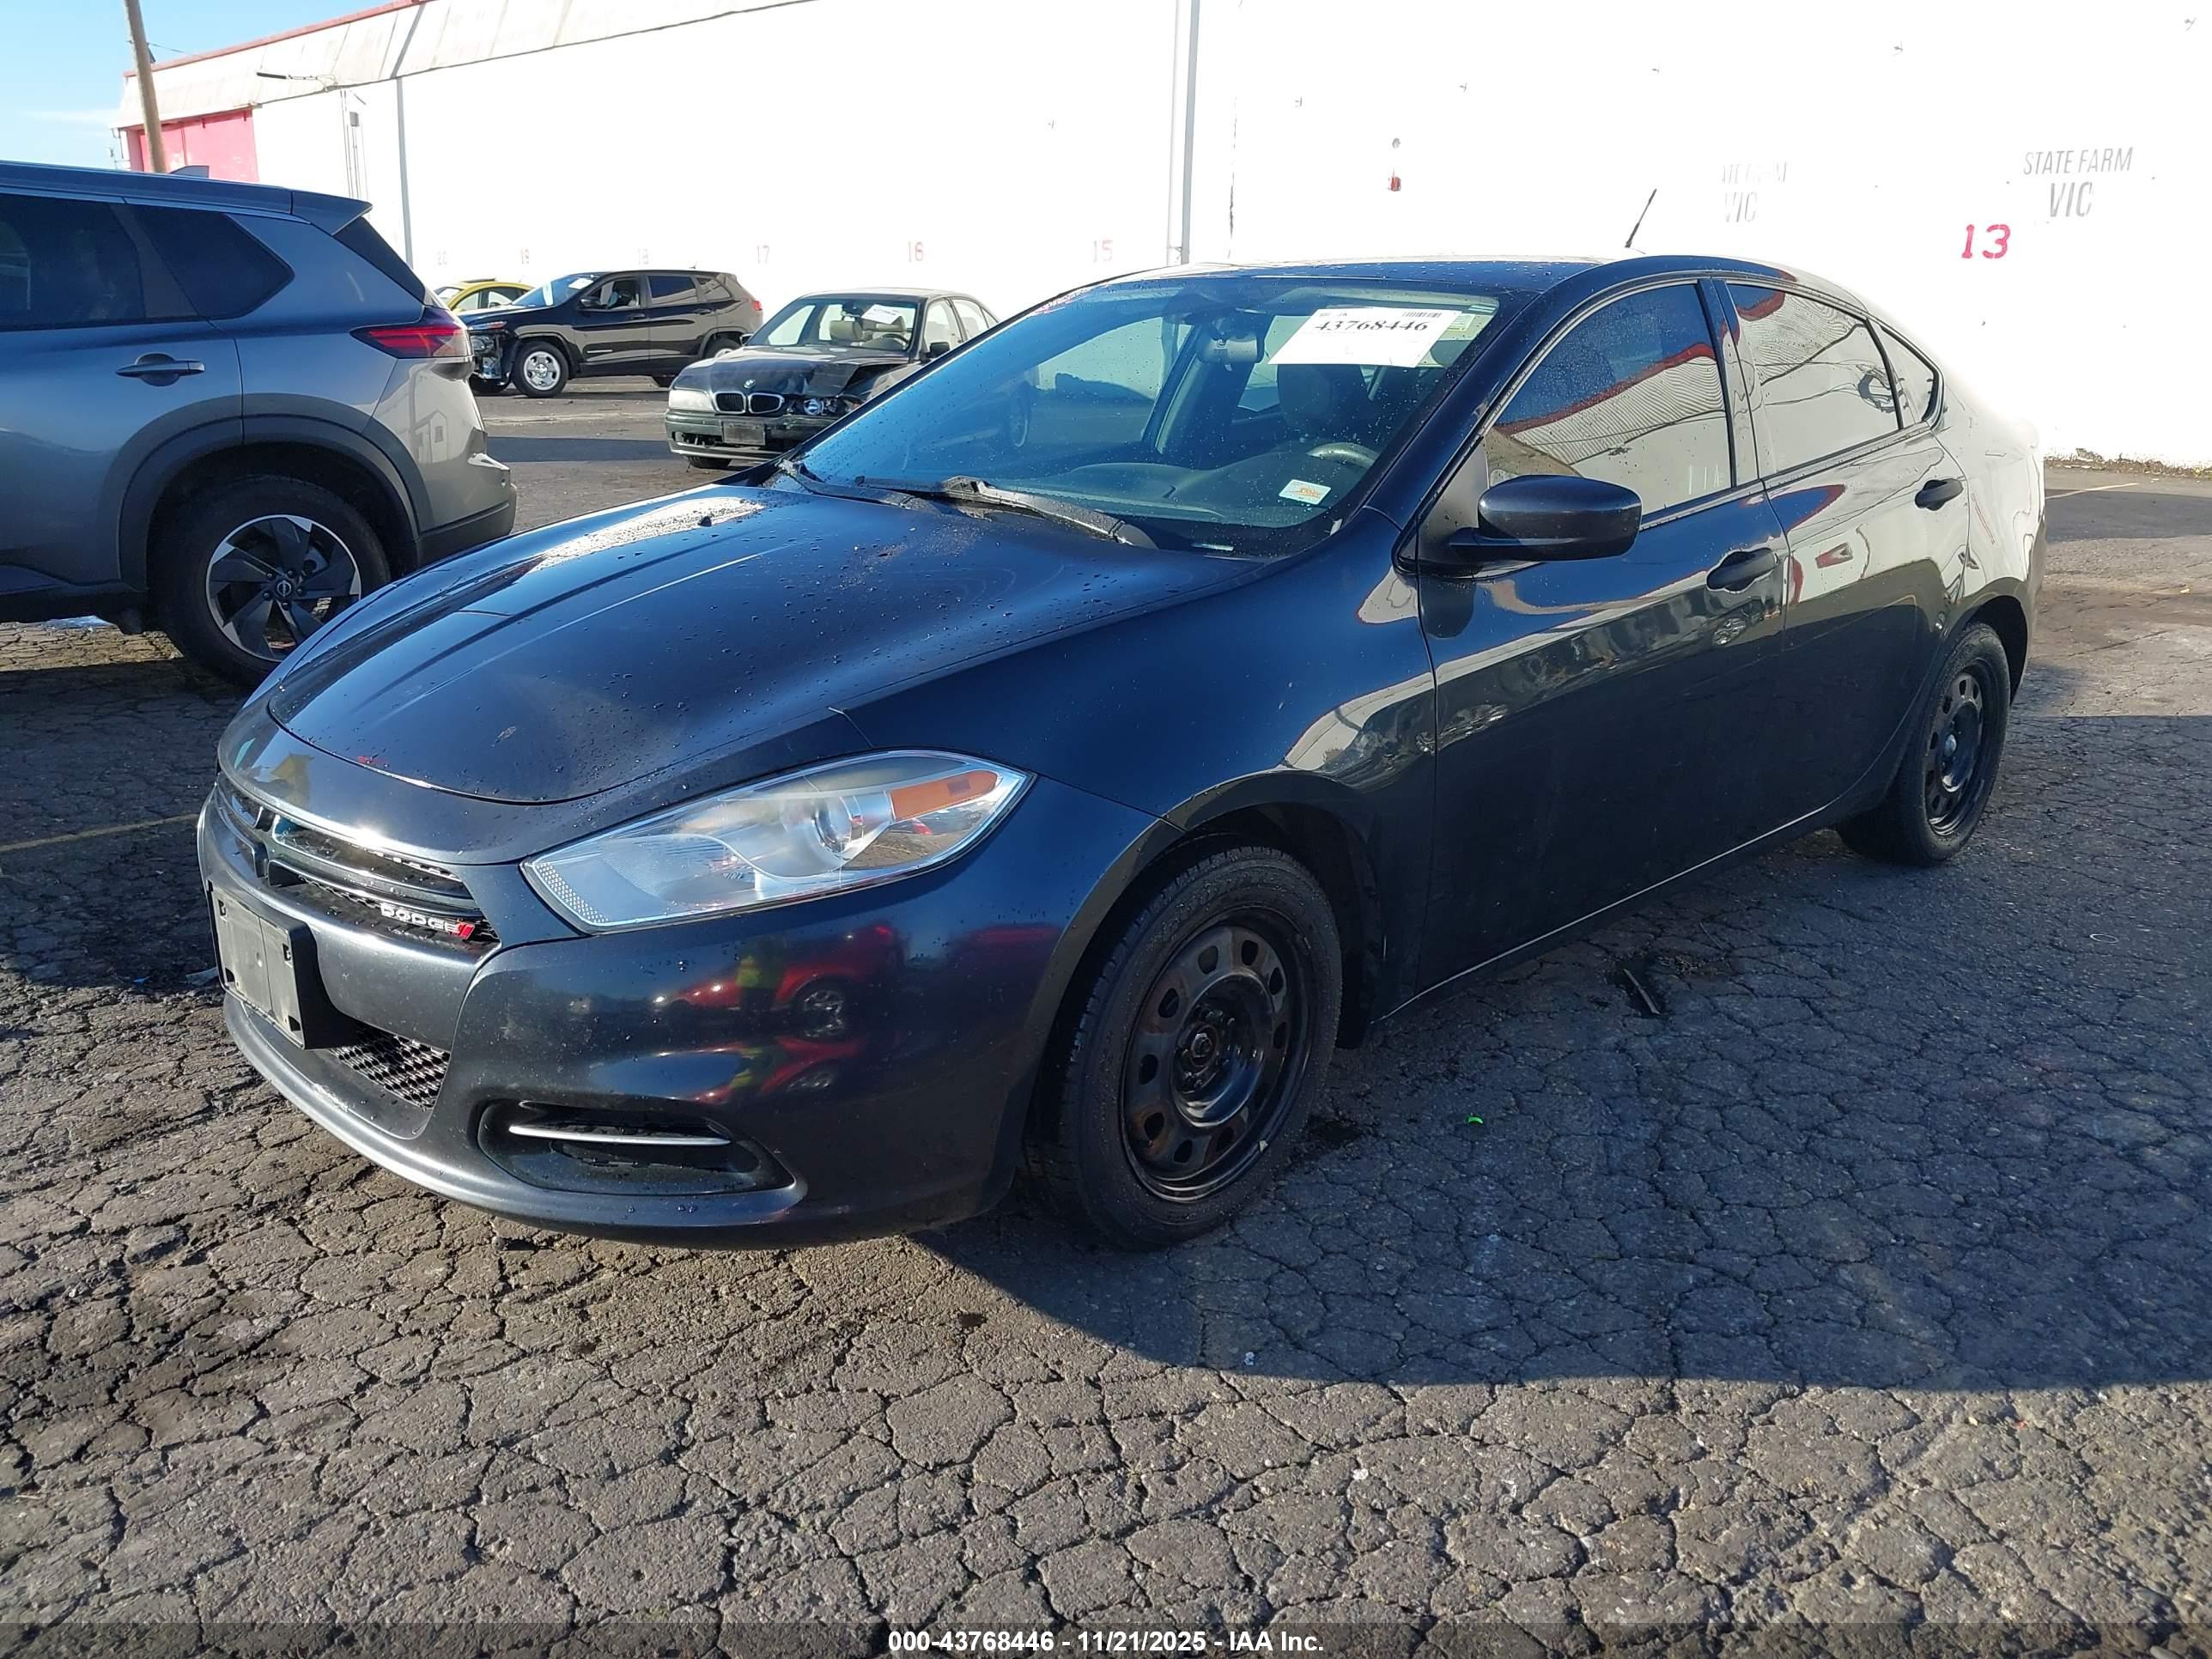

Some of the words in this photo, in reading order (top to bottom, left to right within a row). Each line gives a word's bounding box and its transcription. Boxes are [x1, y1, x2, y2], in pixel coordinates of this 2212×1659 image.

[2023, 149, 2075, 175] STATE
[2078, 147, 2134, 173] FARM
[1724, 191, 1759, 222] VIC
[2050, 181, 2094, 217] VIC
[757, 245, 770, 264] 17
[908, 240, 925, 263] 16
[1093, 240, 1114, 263] 15
[1961, 224, 2011, 259] 13
[1315, 319, 1431, 331] 43768446
[380, 902, 461, 934] DODGE
